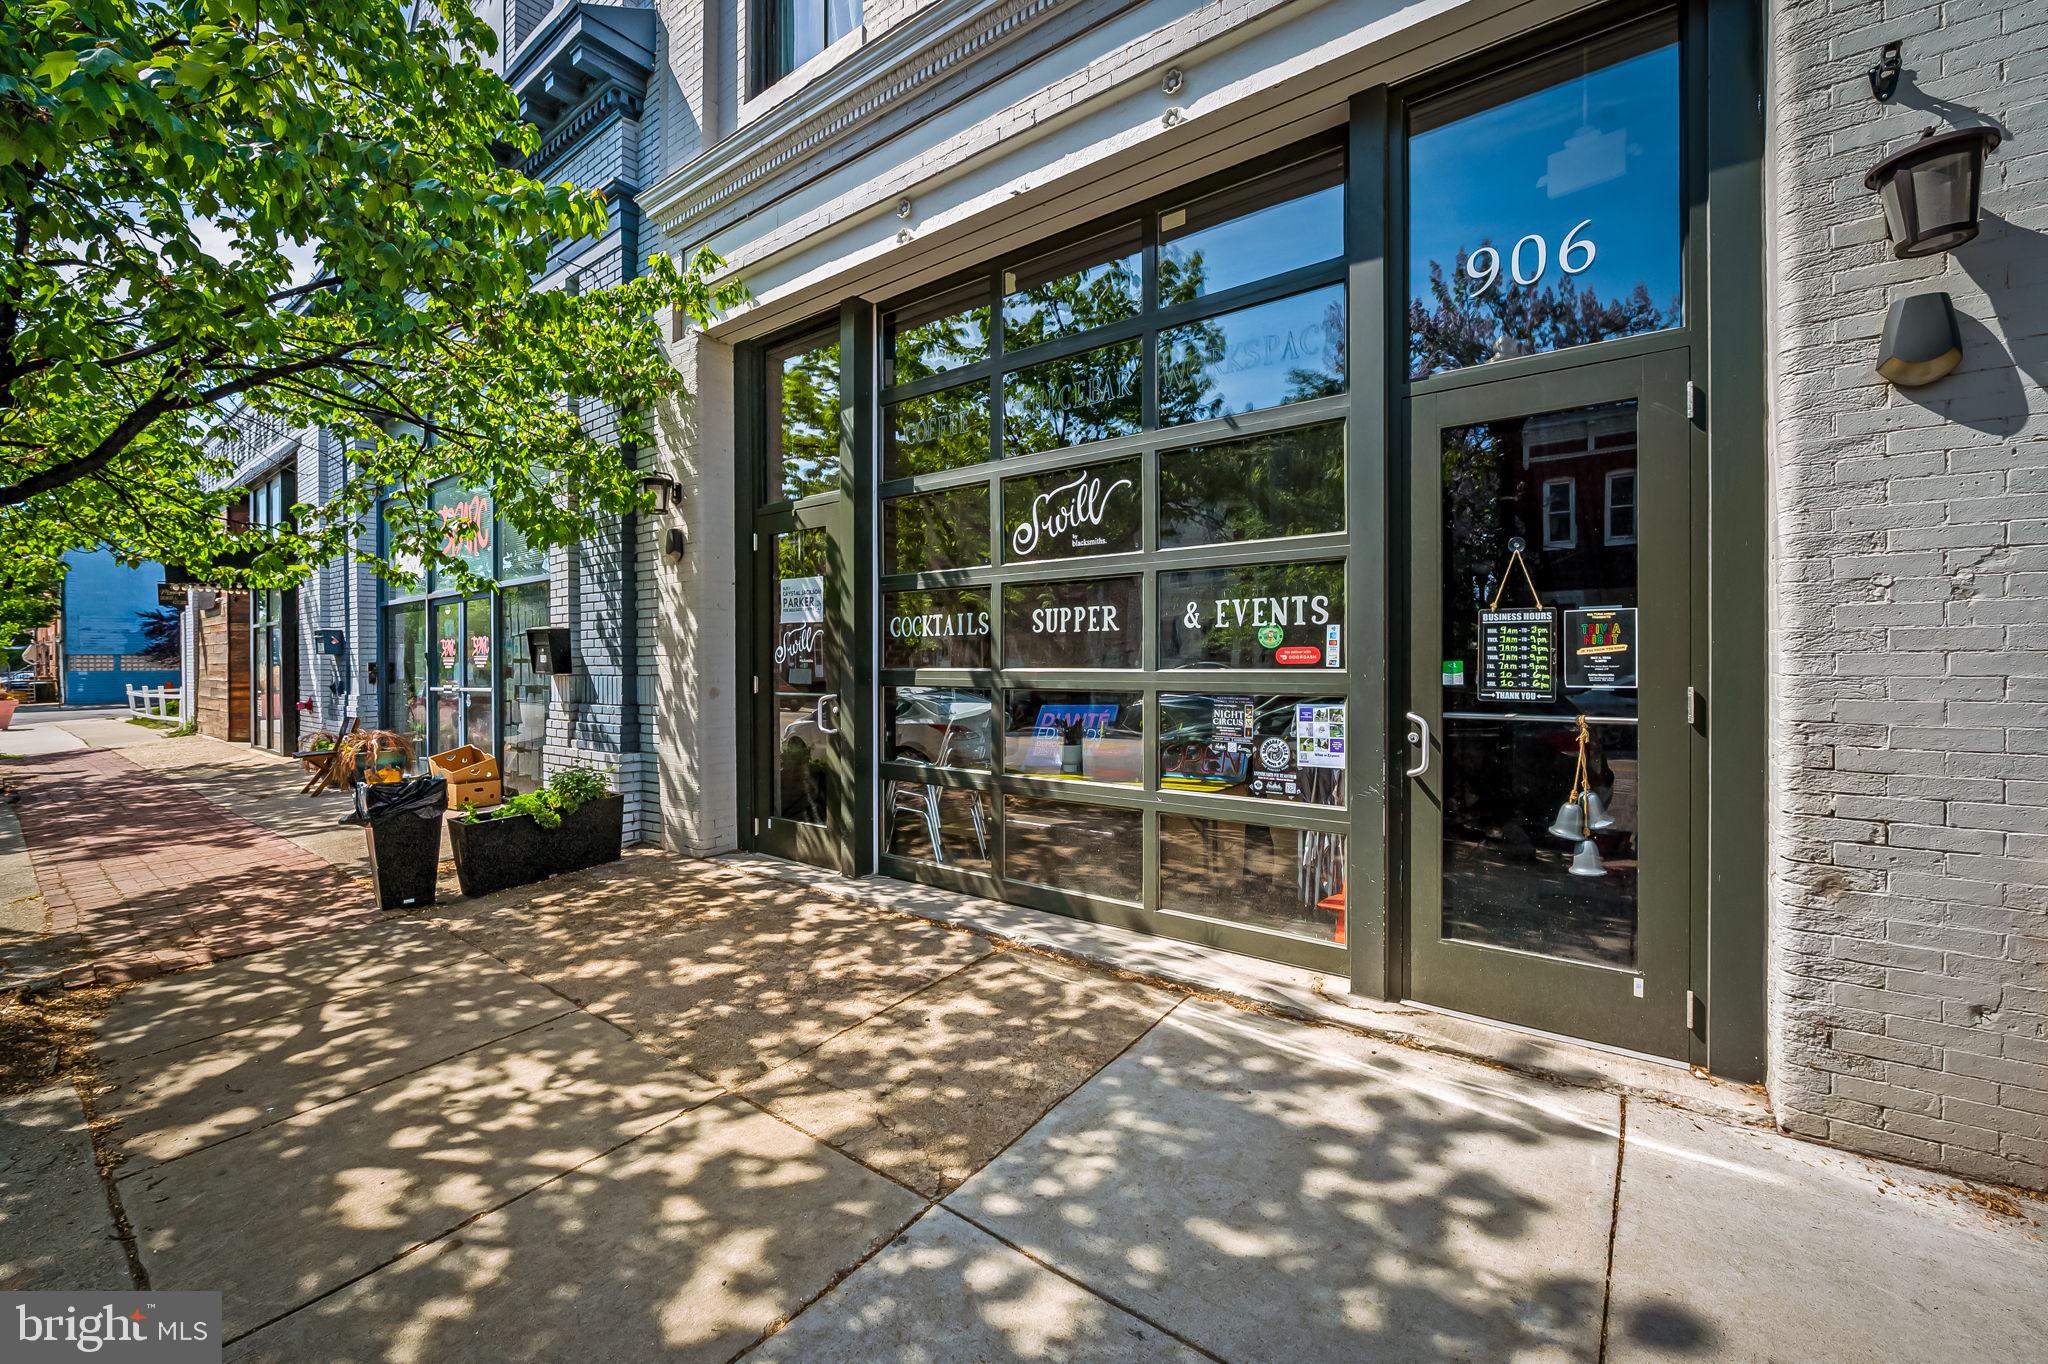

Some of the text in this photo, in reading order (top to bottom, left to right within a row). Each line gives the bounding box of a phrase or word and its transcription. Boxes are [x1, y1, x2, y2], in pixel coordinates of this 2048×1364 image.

[1466, 219, 1596, 297] 906
[1161, 323, 1322, 389] WORKSPAC
[904, 408, 971, 445] COFFEE
[1013, 470, 1132, 555] Swill
[782, 596, 815, 608] PARKER
[1183, 595, 1329, 629] & EVENTS
[890, 612, 989, 638] COCKTAILS
[1032, 605, 1120, 633] SUPPER
[1482, 611, 1553, 621] BUSINESS HOURS
[1581, 623, 1621, 635] TRIVIA
[774, 622, 824, 664] Swill
[1583, 633, 1619, 645] NIGHT
[1495, 691, 1520, 699] THANK
[1212, 717, 1243, 726] CIRCUS
[1213, 709, 1244, 719] NIGHT
